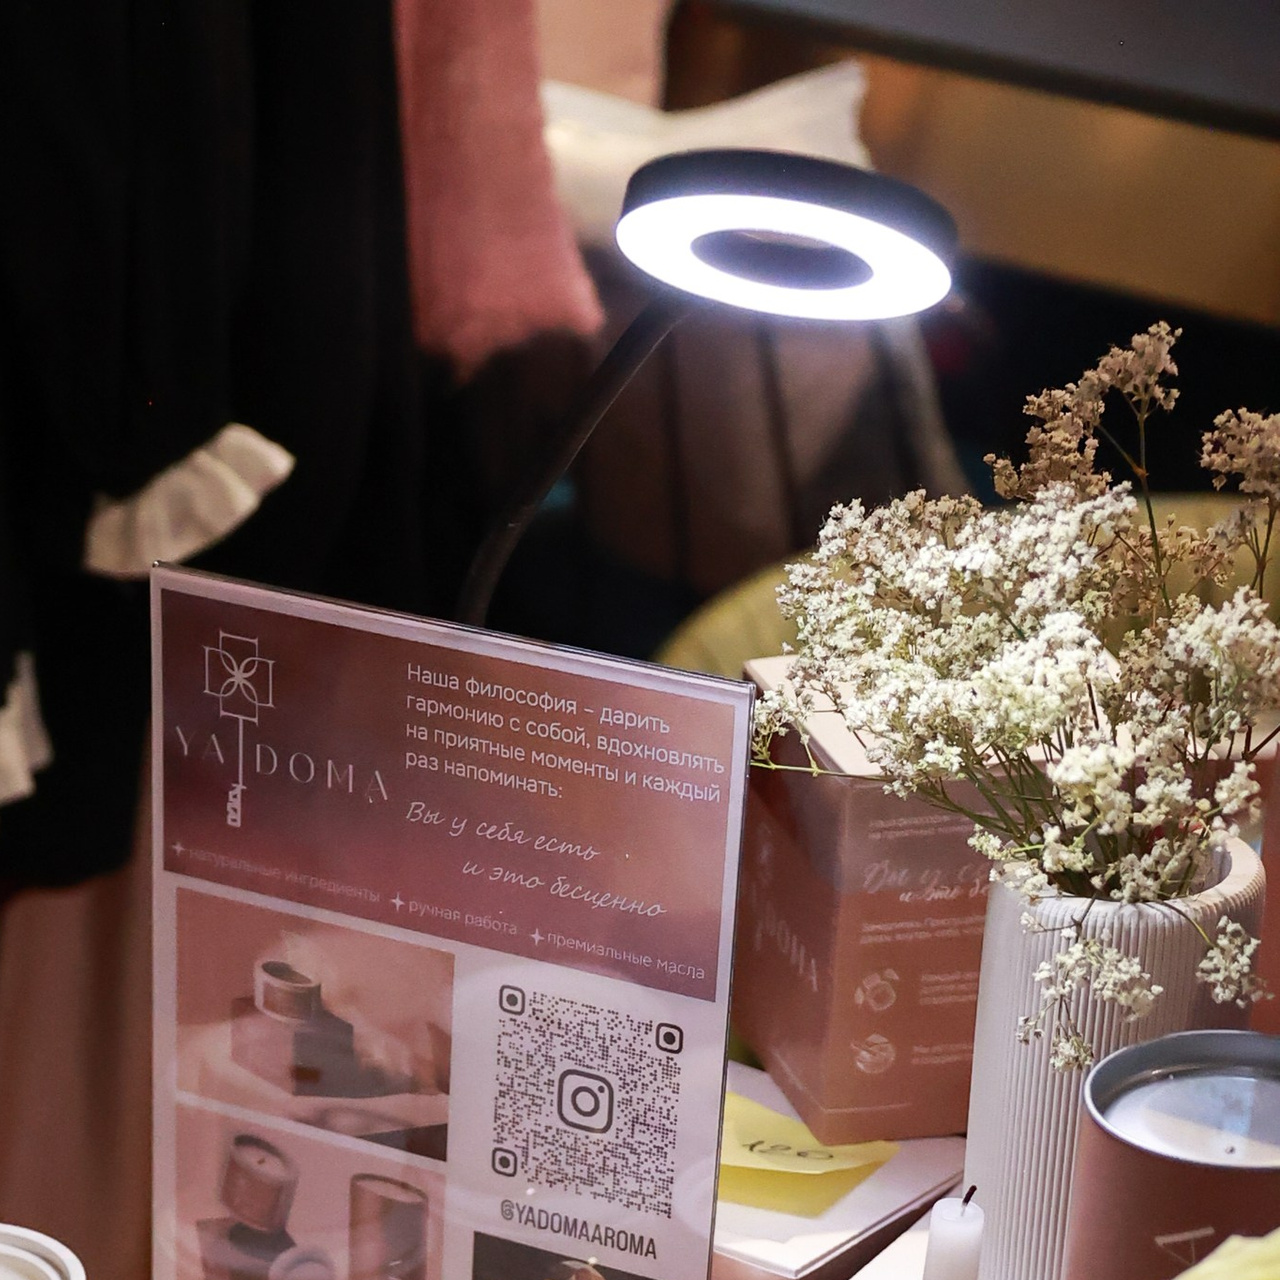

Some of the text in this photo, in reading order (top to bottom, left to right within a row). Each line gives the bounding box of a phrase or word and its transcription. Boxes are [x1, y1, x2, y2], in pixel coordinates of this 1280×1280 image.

[407, 663, 459, 690] Наша
[465, 675, 577, 714] философия
[600, 707, 671, 735] дарить
[406, 695, 726, 775] гармонию с собой, вдохновлять
[406, 723, 721, 803] на приятные моменты и каждый
[405, 750, 564, 799] раз напоминать:
[405, 800, 601, 862] Вы у себя есть
[188, 847, 383, 903] натуральные ингредиенты
[462, 859, 668, 918] и это бесценно
[408, 897, 519, 936] ручная работа
[547, 931, 706, 981] премиальные масла
[500, 1198, 658, 1261] @YADOMAAROMA
